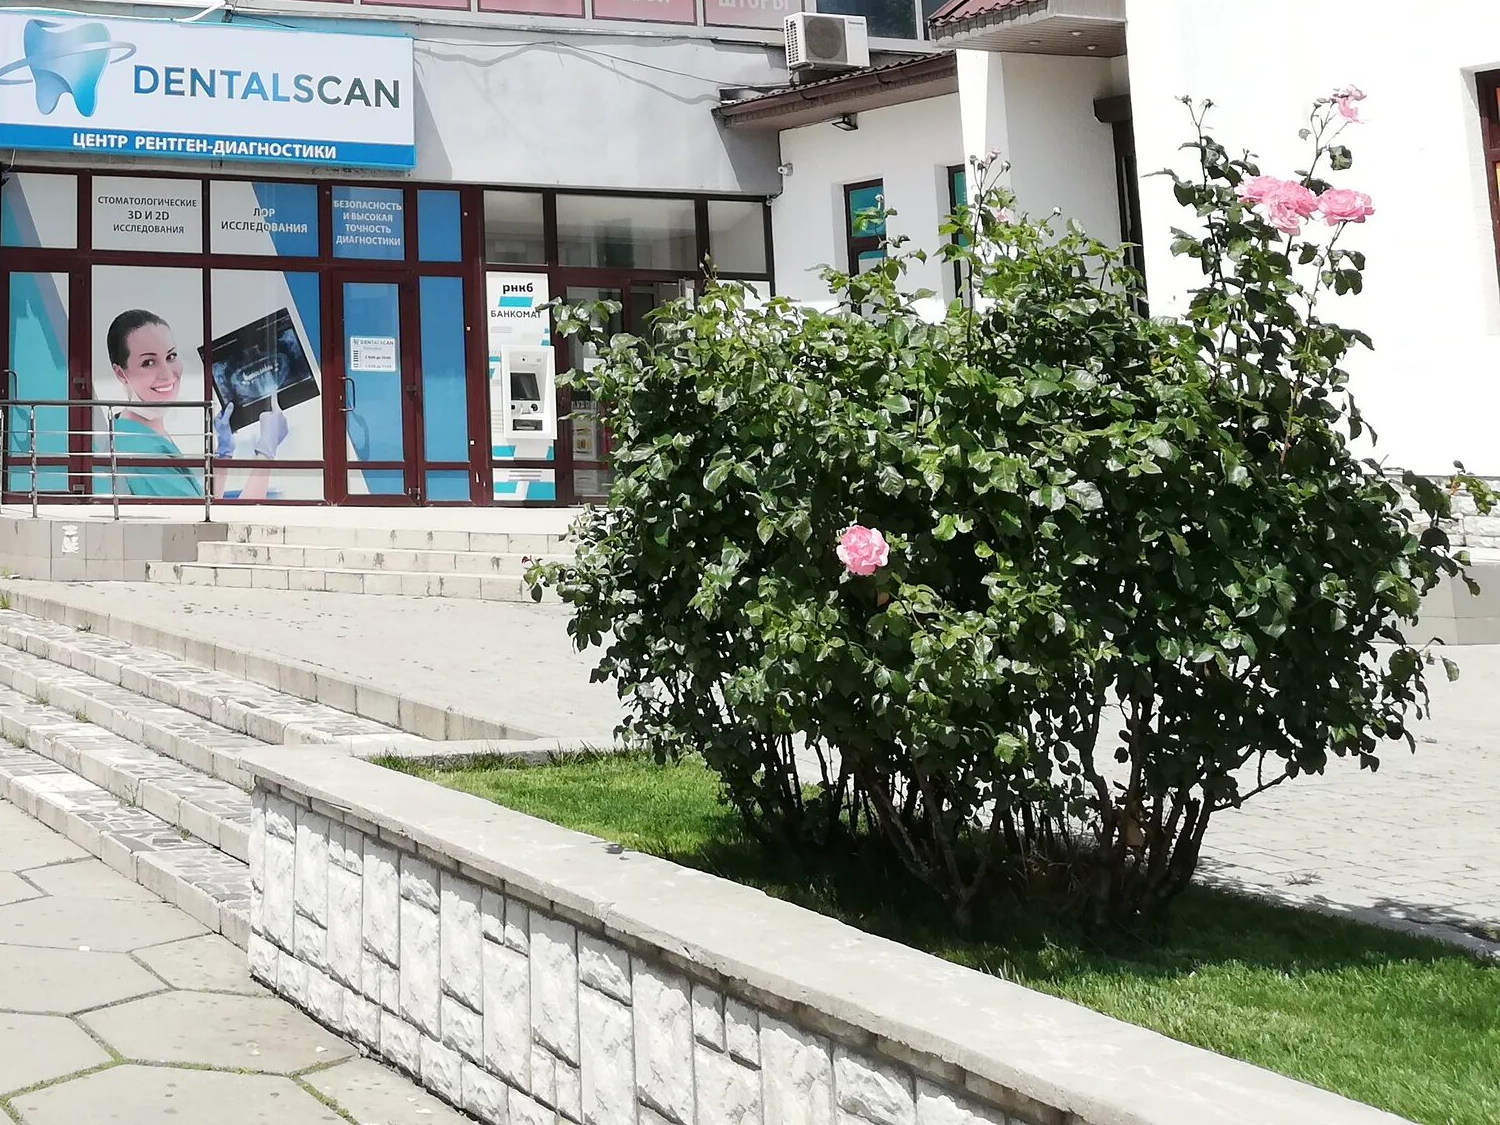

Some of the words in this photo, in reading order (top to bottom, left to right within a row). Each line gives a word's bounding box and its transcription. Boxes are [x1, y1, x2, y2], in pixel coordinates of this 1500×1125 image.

[133, 64, 400, 109] DENTALSCAN
[73, 132, 128, 150] ЦЕНТР
[135, 137, 336, 159] РЕНТГЕН-ДИАГНОСТИКИ
[98, 196, 197, 207] СТОМАТОЛОГИЧЕСКИЕ
[334, 200, 402, 211] БЕЗОПАСНОСТЬ
[128, 211, 142, 219] 3D
[145, 211, 152, 220] И
[155, 211, 169, 221] 2D
[253, 208, 276, 217] ЛОР
[351, 213, 393, 222] ВЫСОКАЯ
[113, 224, 184, 234] ИССЛЕДОВАНИЯ
[221, 221, 308, 233] ИССЛЕДОВАНИЯ
[346, 224, 391, 233] ТОЧНОСТЬ
[336, 235, 400, 246] ДИАГНОСТИКИ
[502, 282, 533, 294] рнкб
[490, 309, 541, 319] БАНКОМАТ
